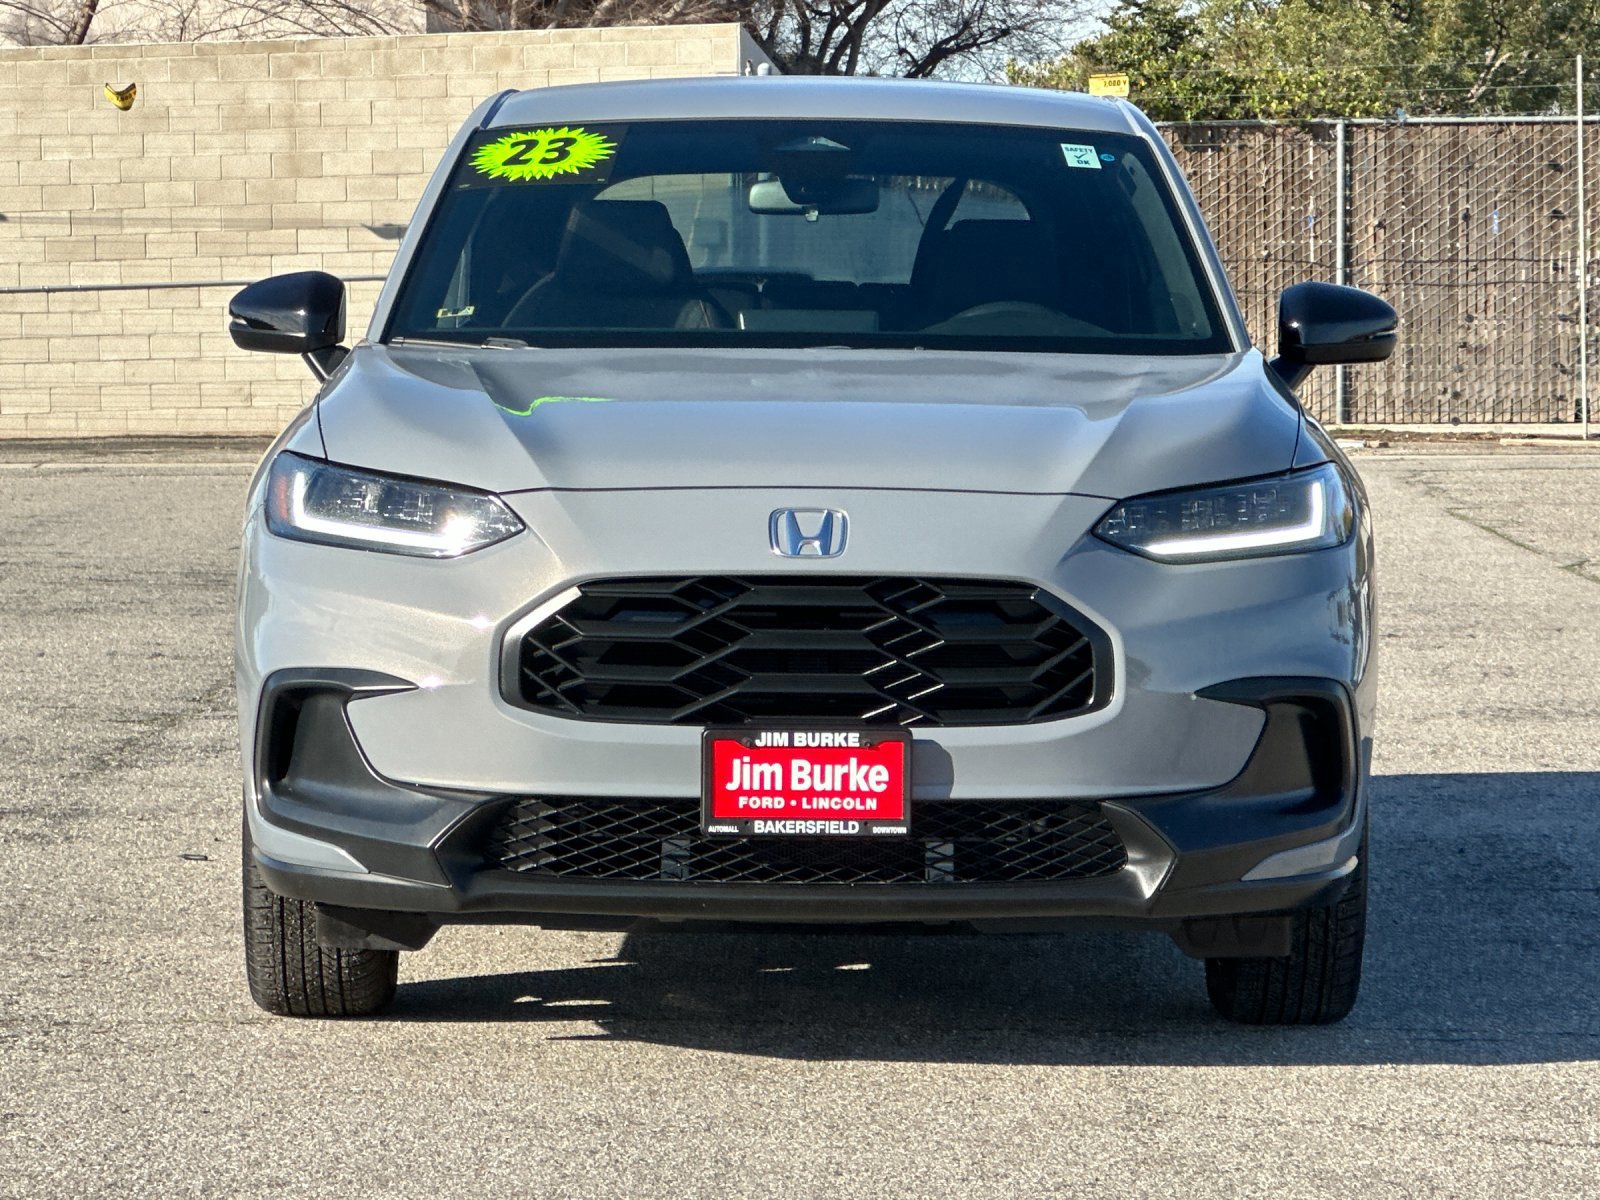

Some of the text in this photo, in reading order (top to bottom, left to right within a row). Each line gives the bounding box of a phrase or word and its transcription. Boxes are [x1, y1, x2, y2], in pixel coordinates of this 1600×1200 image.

[501, 136, 578, 167] 23
[755, 732, 860, 747] JIM BURKE
[725, 756, 889, 792] Jim Burke
[738, 796, 877, 810] FORD LINCOLN
[708, 825, 739, 833] AUTOMALL
[754, 820, 860, 834] BAKERSFIELD
[872, 826, 907, 834] DOWNTOWN
